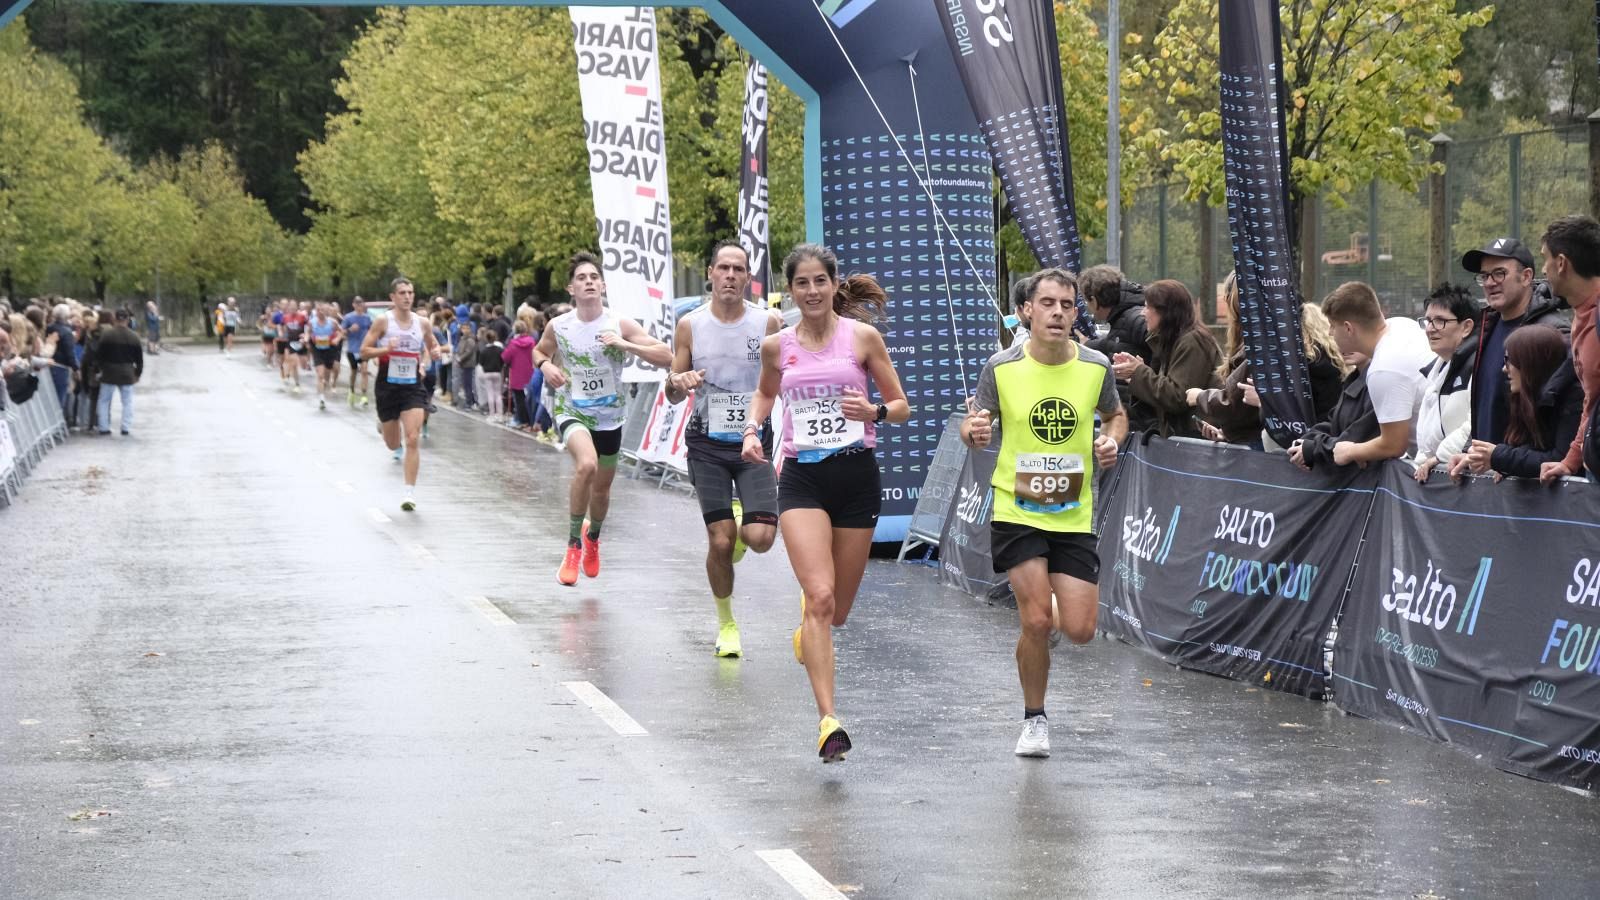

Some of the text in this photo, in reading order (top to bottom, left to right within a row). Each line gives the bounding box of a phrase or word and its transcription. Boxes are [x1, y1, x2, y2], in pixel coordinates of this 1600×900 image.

[582, 379, 604, 391] 201
[726, 409, 746, 422] 33
[795, 406, 816, 415] SALTO
[807, 416, 847, 437] 382
[814, 437, 842, 445] NAIARA
[1030, 476, 1070, 493] 699
[1214, 504, 1275, 548] SALTO
[1382, 558, 1457, 631] salto
[1528, 679, 1557, 706] .org
